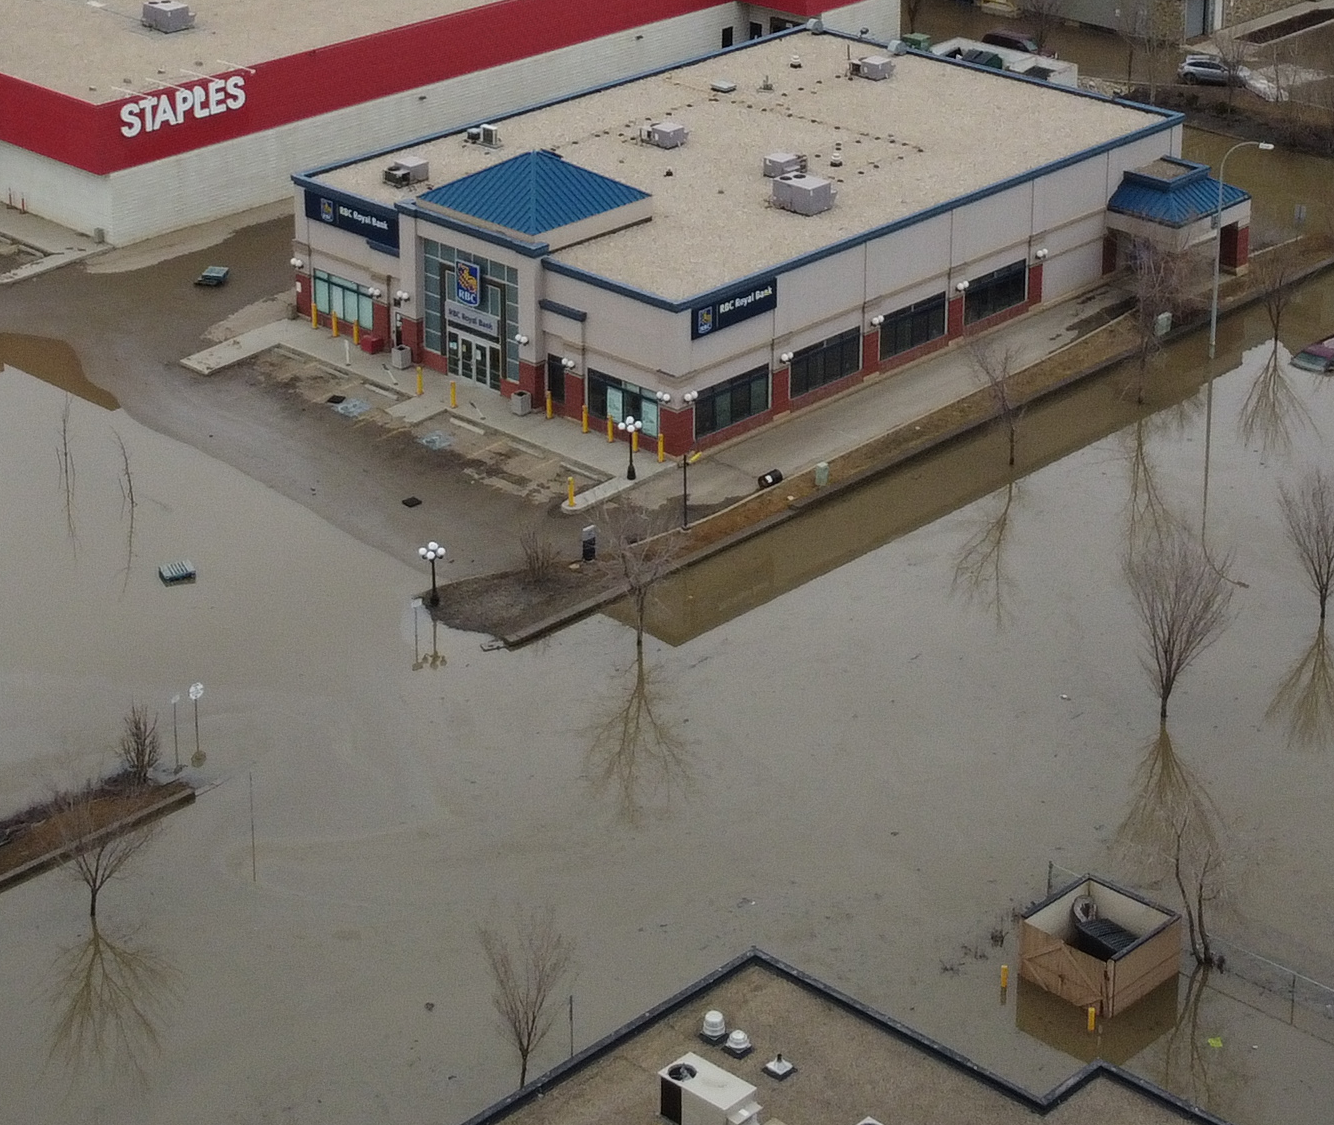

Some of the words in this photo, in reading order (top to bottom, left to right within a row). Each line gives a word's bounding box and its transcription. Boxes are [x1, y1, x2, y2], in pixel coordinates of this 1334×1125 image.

[120, 75, 246, 138] STAPLES
[339, 206, 352, 218] RBC
[353, 210, 371, 225] Royal
[372, 216, 389, 230] Bank
[458, 288, 476, 304] RBC
[719, 300, 734, 314] RBC
[734, 292, 754, 308] Royal
[755, 286, 773, 300] Bank
[448, 308, 460, 319] RBC
[461, 313, 477, 325] Royal
[478, 318, 493, 331] Bank
